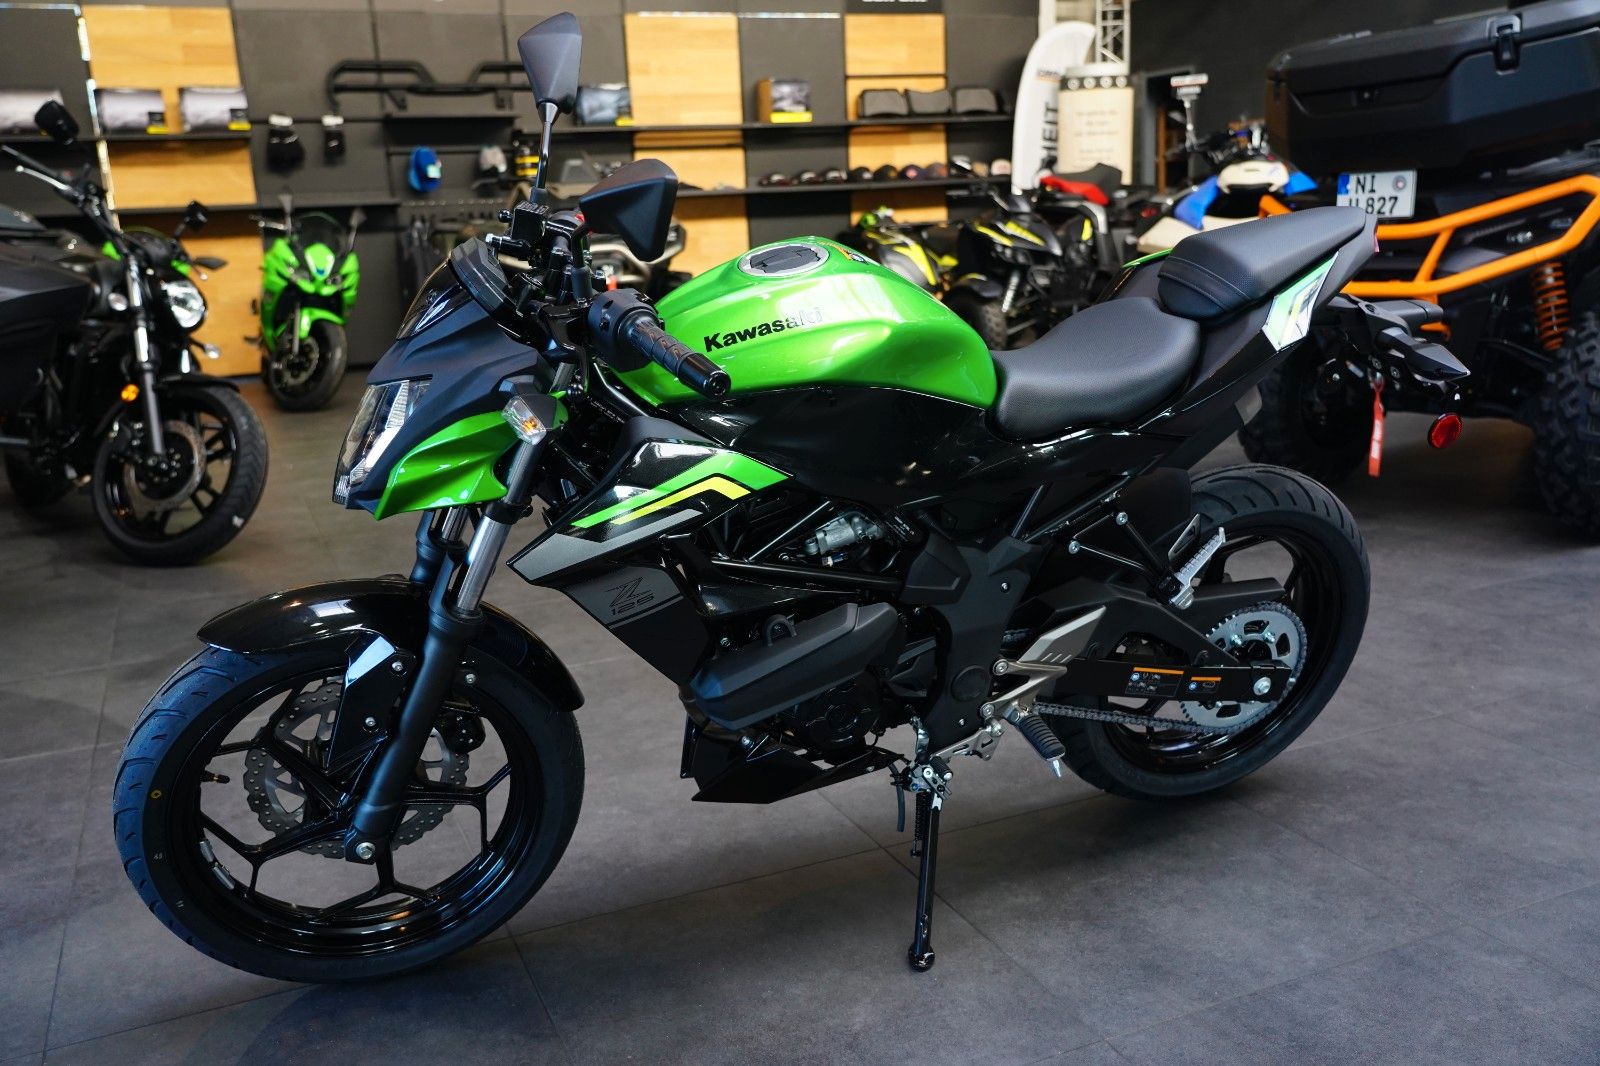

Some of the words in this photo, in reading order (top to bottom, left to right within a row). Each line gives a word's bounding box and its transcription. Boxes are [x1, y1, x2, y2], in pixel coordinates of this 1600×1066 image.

[1355, 174, 1376, 194] NI
[1365, 196, 1398, 215] 827
[611, 593, 655, 615] 125
